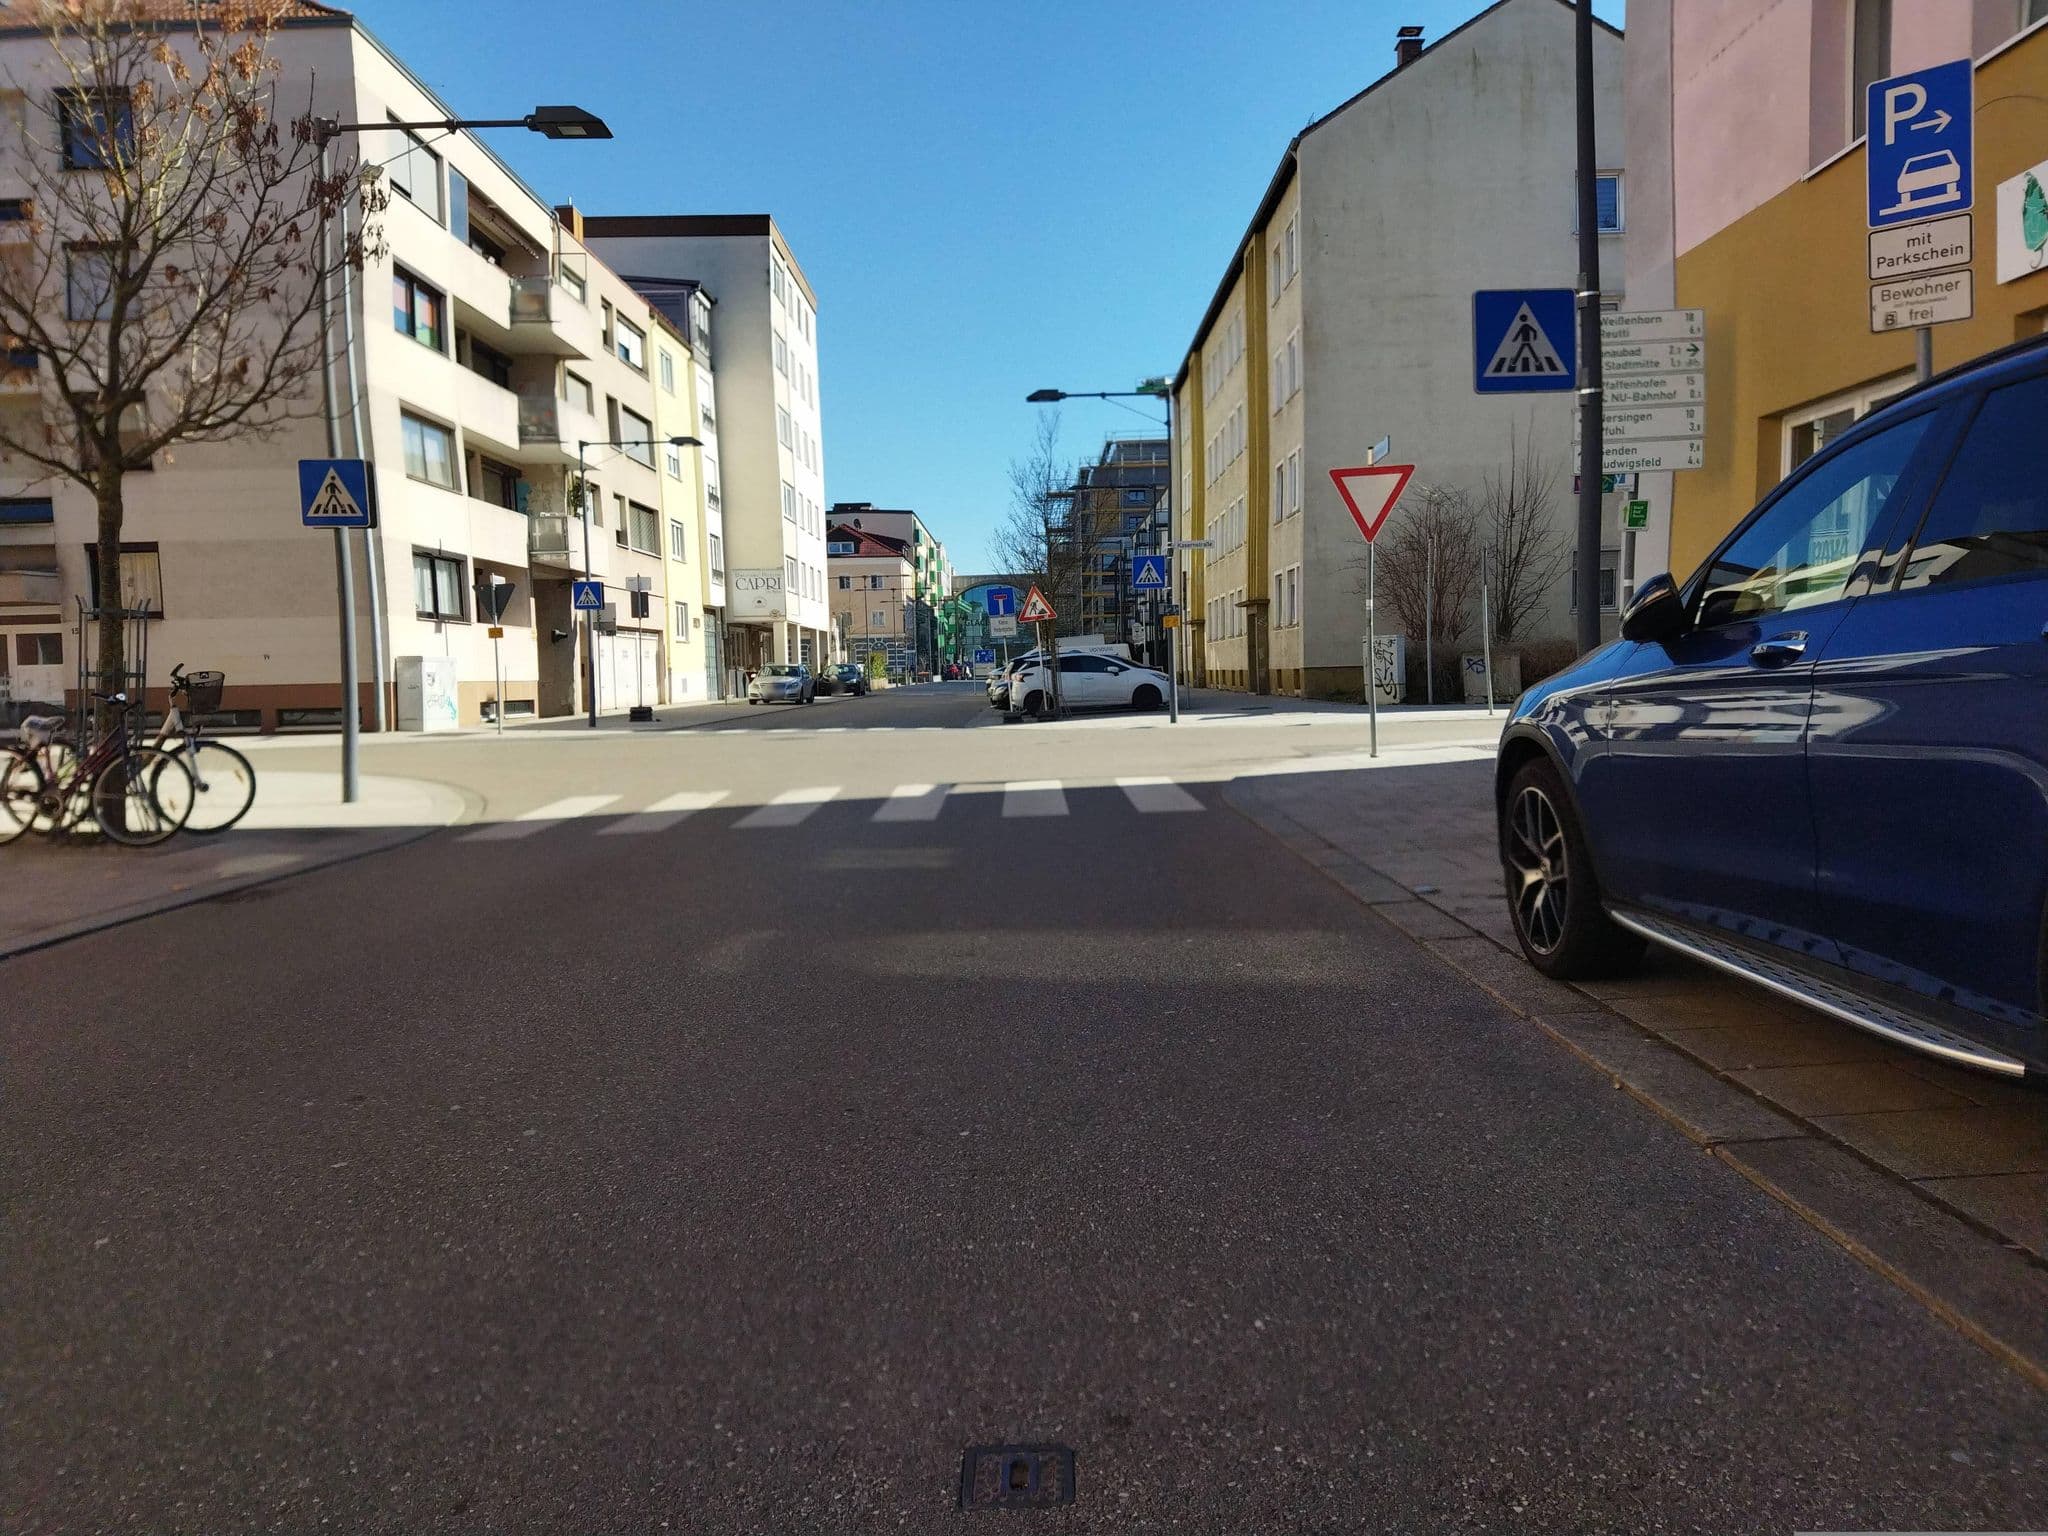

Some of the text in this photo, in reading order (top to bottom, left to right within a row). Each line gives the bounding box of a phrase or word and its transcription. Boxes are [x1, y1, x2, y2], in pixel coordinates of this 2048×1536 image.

[1907, 233, 1932, 248] mit
[1877, 244, 1964, 269] Parkschein
[1881, 280, 1960, 302] Bewohner
[1909, 306, 1934, 320] frei
[1601, 377, 1667, 390] faffenhofen
[1611, 391, 1677, 402] NU-Bahnhof
[1602, 426, 1625, 435] fuhl
[1602, 457, 1662, 469] udwigsfeld
[735, 577, 781, 590] CAPRI
